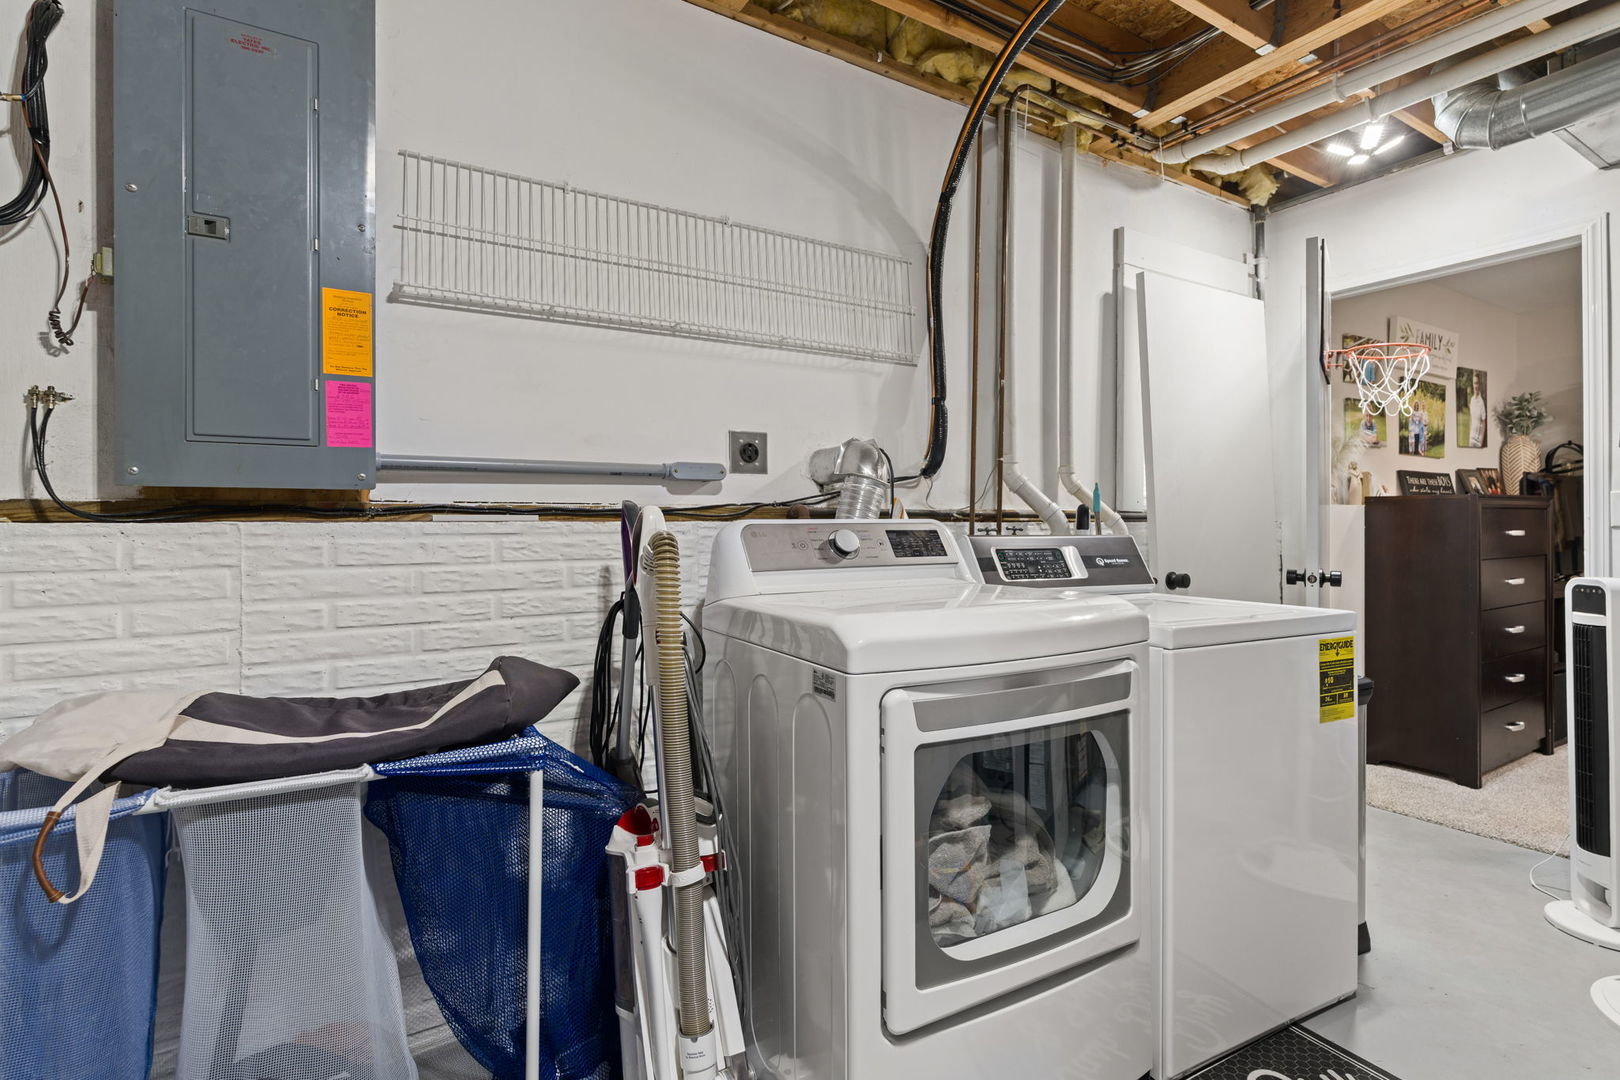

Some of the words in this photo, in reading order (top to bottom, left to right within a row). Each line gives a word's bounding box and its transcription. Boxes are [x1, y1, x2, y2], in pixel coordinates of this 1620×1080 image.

[328, 306, 367, 314] CORRECTION
[1415, 330, 1444, 351] FAMILY
[1437, 475, 1452, 487] BOYS
